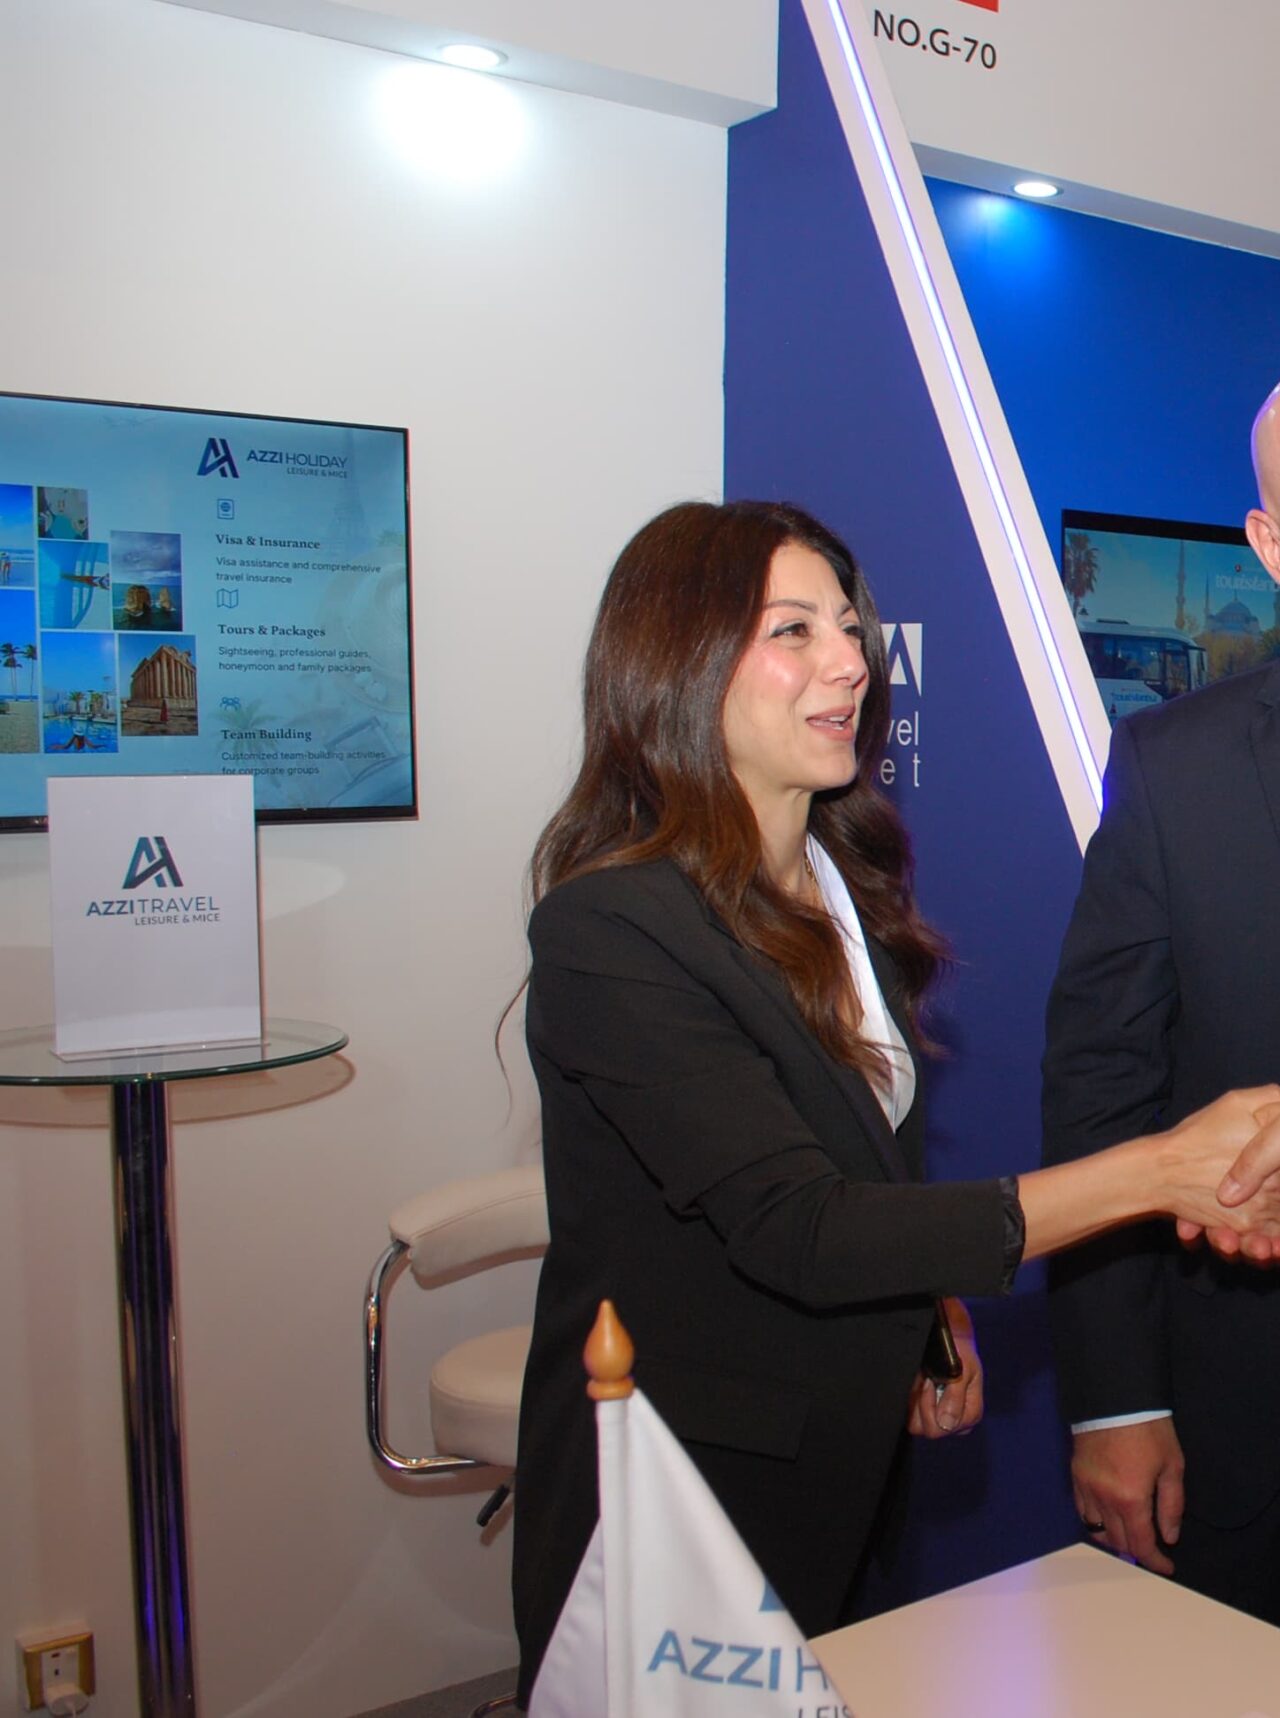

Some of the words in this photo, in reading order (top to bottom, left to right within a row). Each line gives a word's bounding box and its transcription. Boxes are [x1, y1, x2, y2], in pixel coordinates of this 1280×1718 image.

[873, 9, 997, 69] NO.G-70
[246, 450, 283, 464] AZZI
[285, 453, 348, 468] HOLIDAY
[287, 467, 319, 477] LEISURE
[328, 470, 348, 479] MICE
[215, 533, 243, 546] Visa
[246, 535, 257, 546] &
[259, 536, 321, 550] Insurance
[215, 557, 237, 567] Visa
[239, 558, 290, 570] assistance
[292, 559, 310, 570] and
[311, 560, 382, 574] comprehensive
[216, 572, 244, 582] travel
[246, 573, 293, 584] insurance
[217, 624, 255, 636] Tours
[257, 625, 268, 636] &
[271, 625, 326, 639] Packages
[279, 648, 337, 661] professional
[218, 662, 275, 673] honeymoon
[277, 662, 295, 672] and
[297, 663, 325, 674] family
[327, 663, 372, 674] packages
[221, 729, 256, 740] Team
[259, 729, 312, 742] Building
[221, 751, 279, 761] Customized
[280, 751, 344, 762] team-building
[222, 766, 237, 775] for
[238, 767, 286, 777] corporate
[287, 767, 320, 777] groups
[86, 899, 134, 916] AZZI
[137, 896, 220, 914] TRAVEL
[134, 914, 180, 926] LEISURE
[182, 914, 190, 924] &
[192, 912, 221, 923] MICE
[646, 1629, 782, 1691] AZZI
